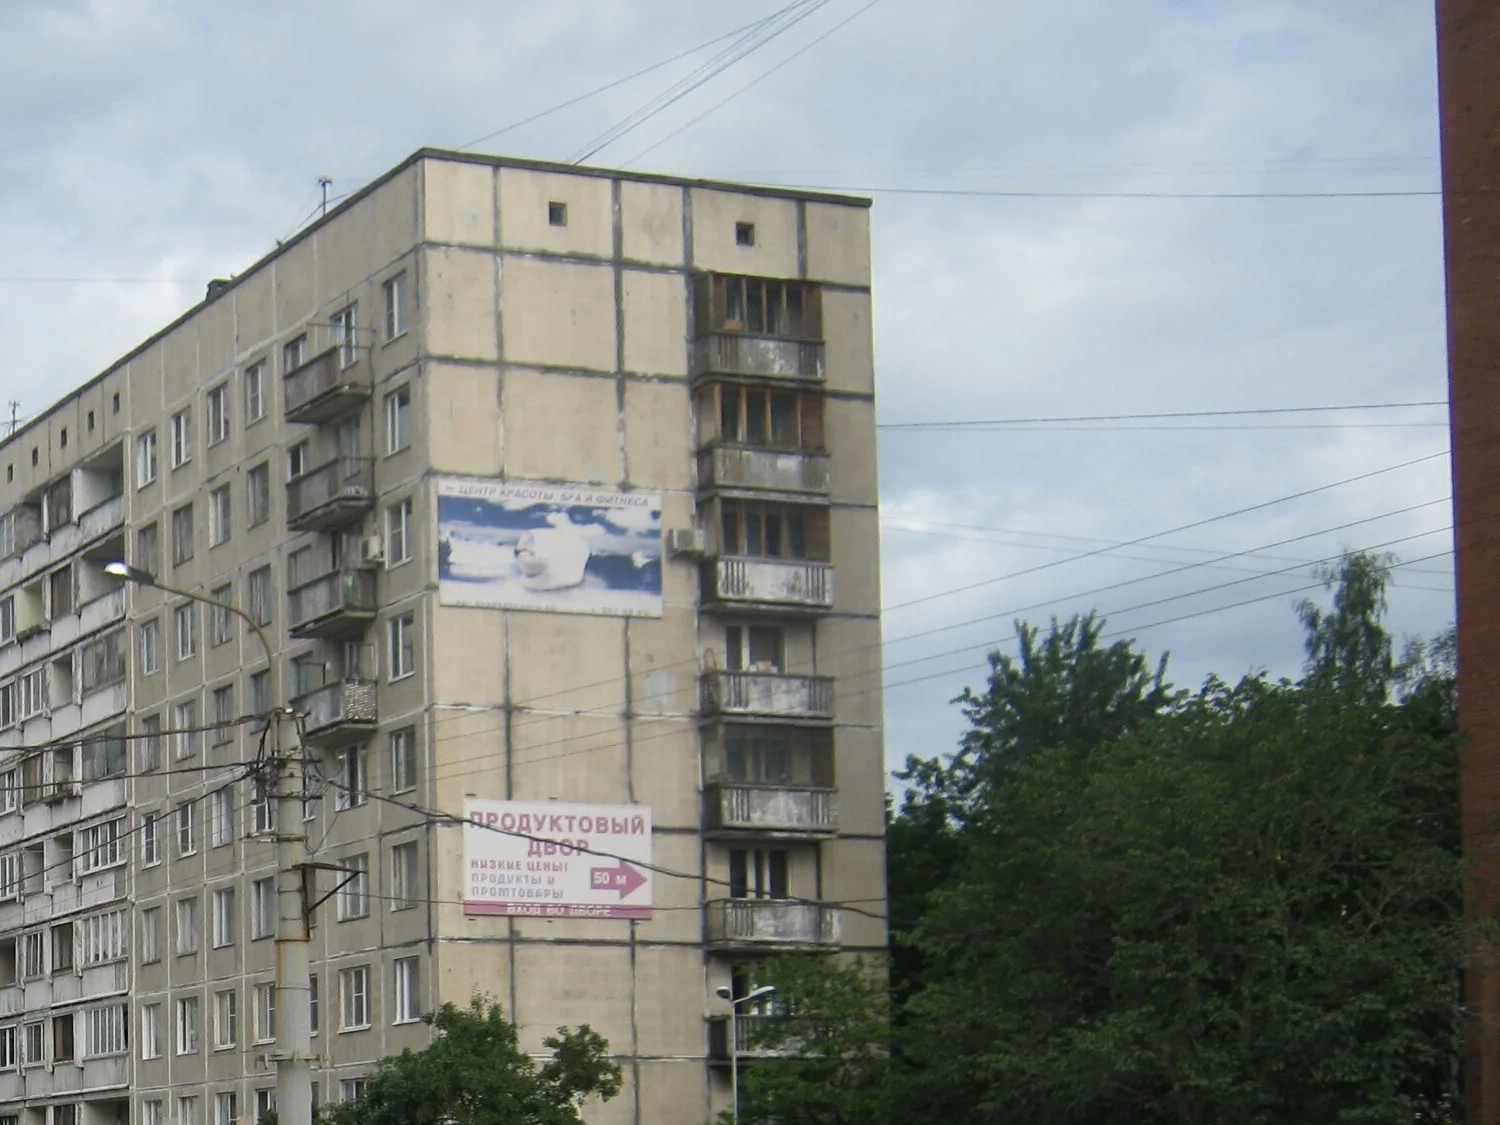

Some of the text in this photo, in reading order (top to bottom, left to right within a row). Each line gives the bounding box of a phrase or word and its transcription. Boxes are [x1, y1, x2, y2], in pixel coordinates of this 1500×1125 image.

[459, 485, 497, 497] ЦЕНТР
[596, 495, 649, 507] ФИТНЕСА
[469, 810, 645, 836] ПРОДУКТОВЫЙ
[527, 838, 589, 858] ДВОР
[471, 859, 523, 871] НИЗКИЕ
[471, 872, 542, 886] ПРОДУКТЫ
[593, 871, 611, 885] 50
[472, 886, 565, 900] ПРОМТОВАРЫ
[507, 902, 612, 918] ВХОД ВО ДВОРЕ
